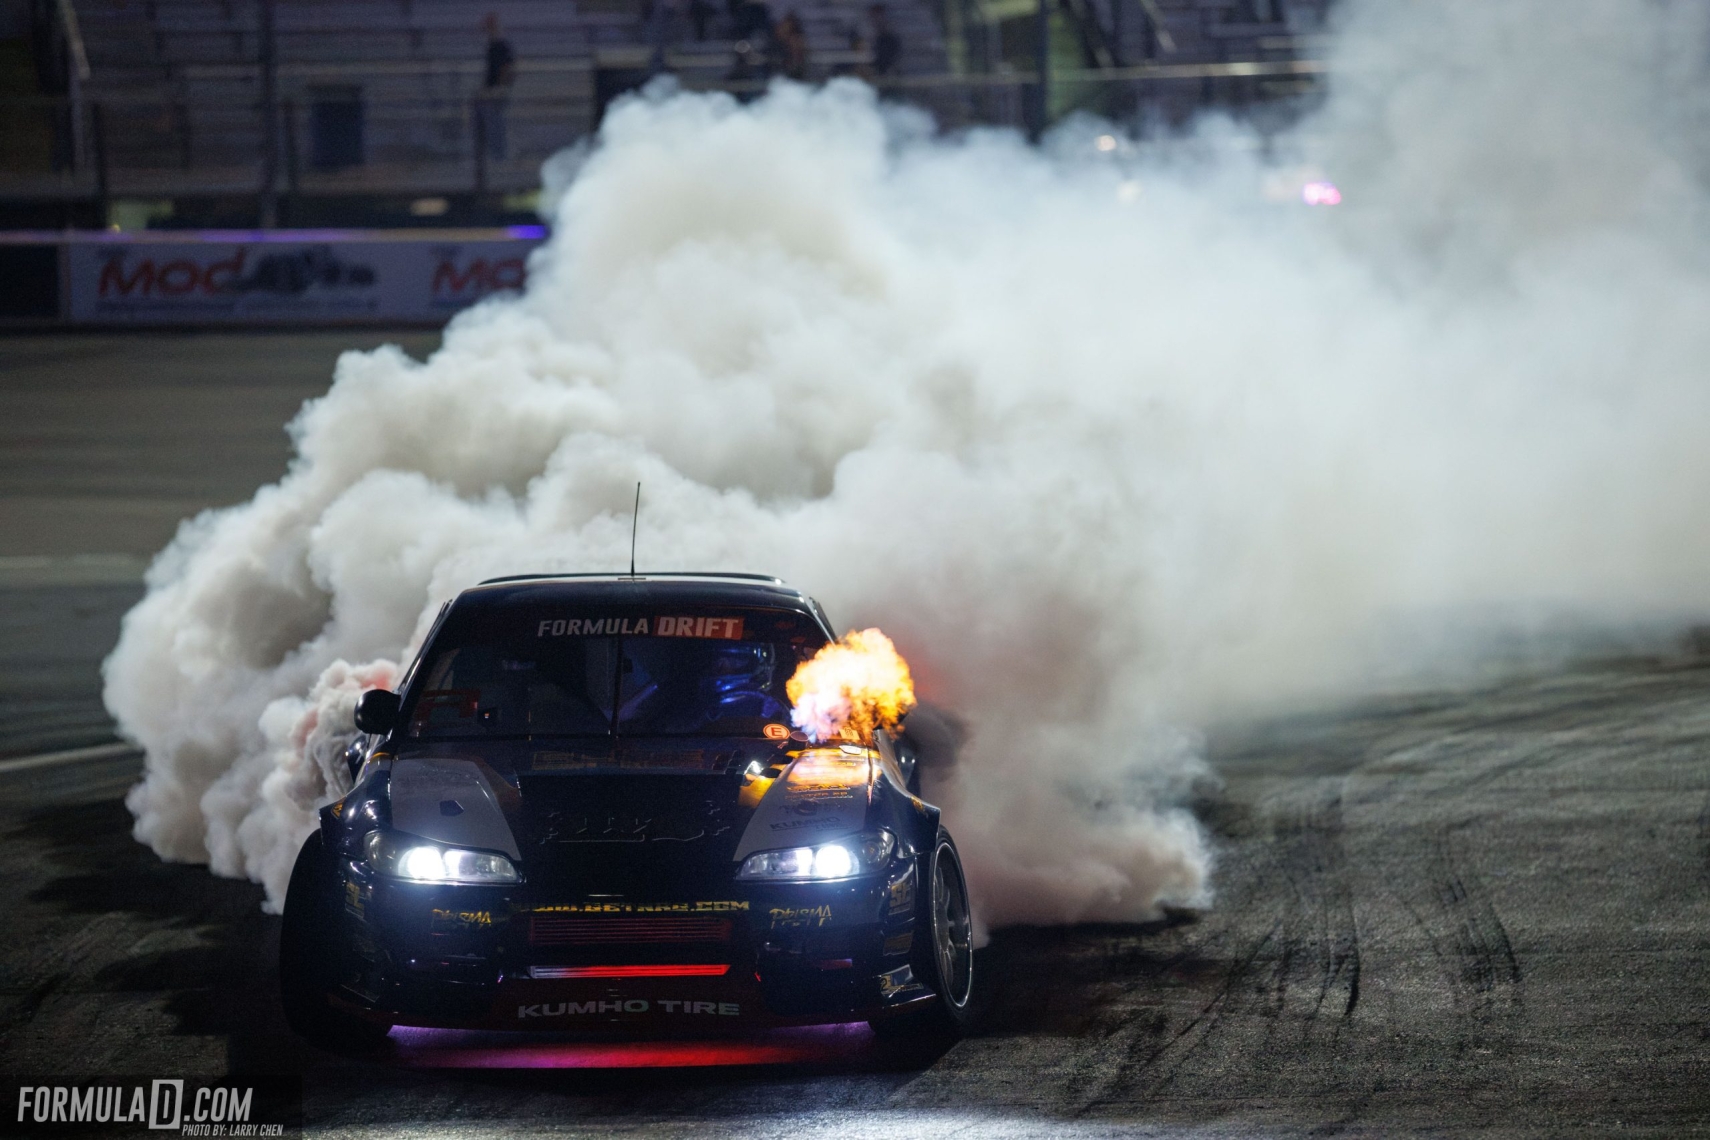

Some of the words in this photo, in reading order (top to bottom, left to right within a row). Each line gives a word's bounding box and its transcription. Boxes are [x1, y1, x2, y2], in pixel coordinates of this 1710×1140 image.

[537, 618, 649, 637] FORMULA
[657, 616, 739, 638] DRIFT
[518, 999, 650, 1019] KUMHO
[657, 1000, 740, 1016] TIRE
